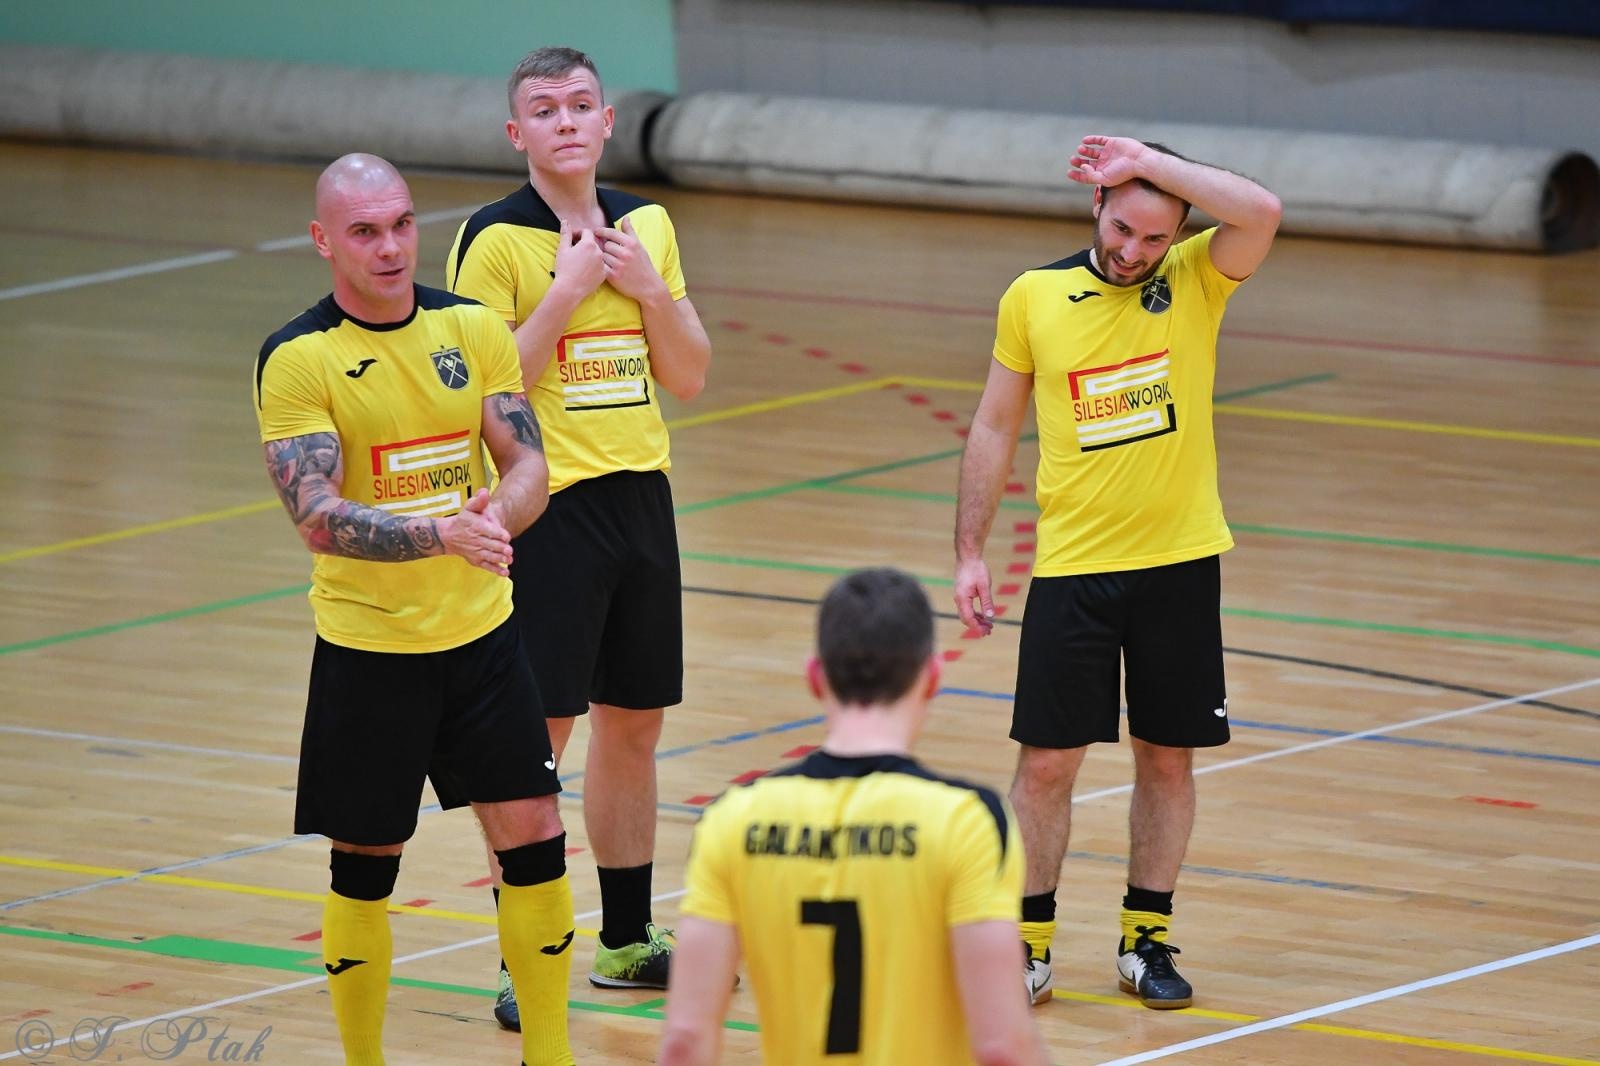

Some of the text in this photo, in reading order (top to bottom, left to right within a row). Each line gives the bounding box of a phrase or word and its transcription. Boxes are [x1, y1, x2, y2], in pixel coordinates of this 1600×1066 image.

[559, 357, 647, 384] SILESIAWORK
[1073, 380, 1173, 423] SILESIAWORK
[372, 462, 472, 500] SILESIAWORK
[800, 900, 863, 1055] 7
